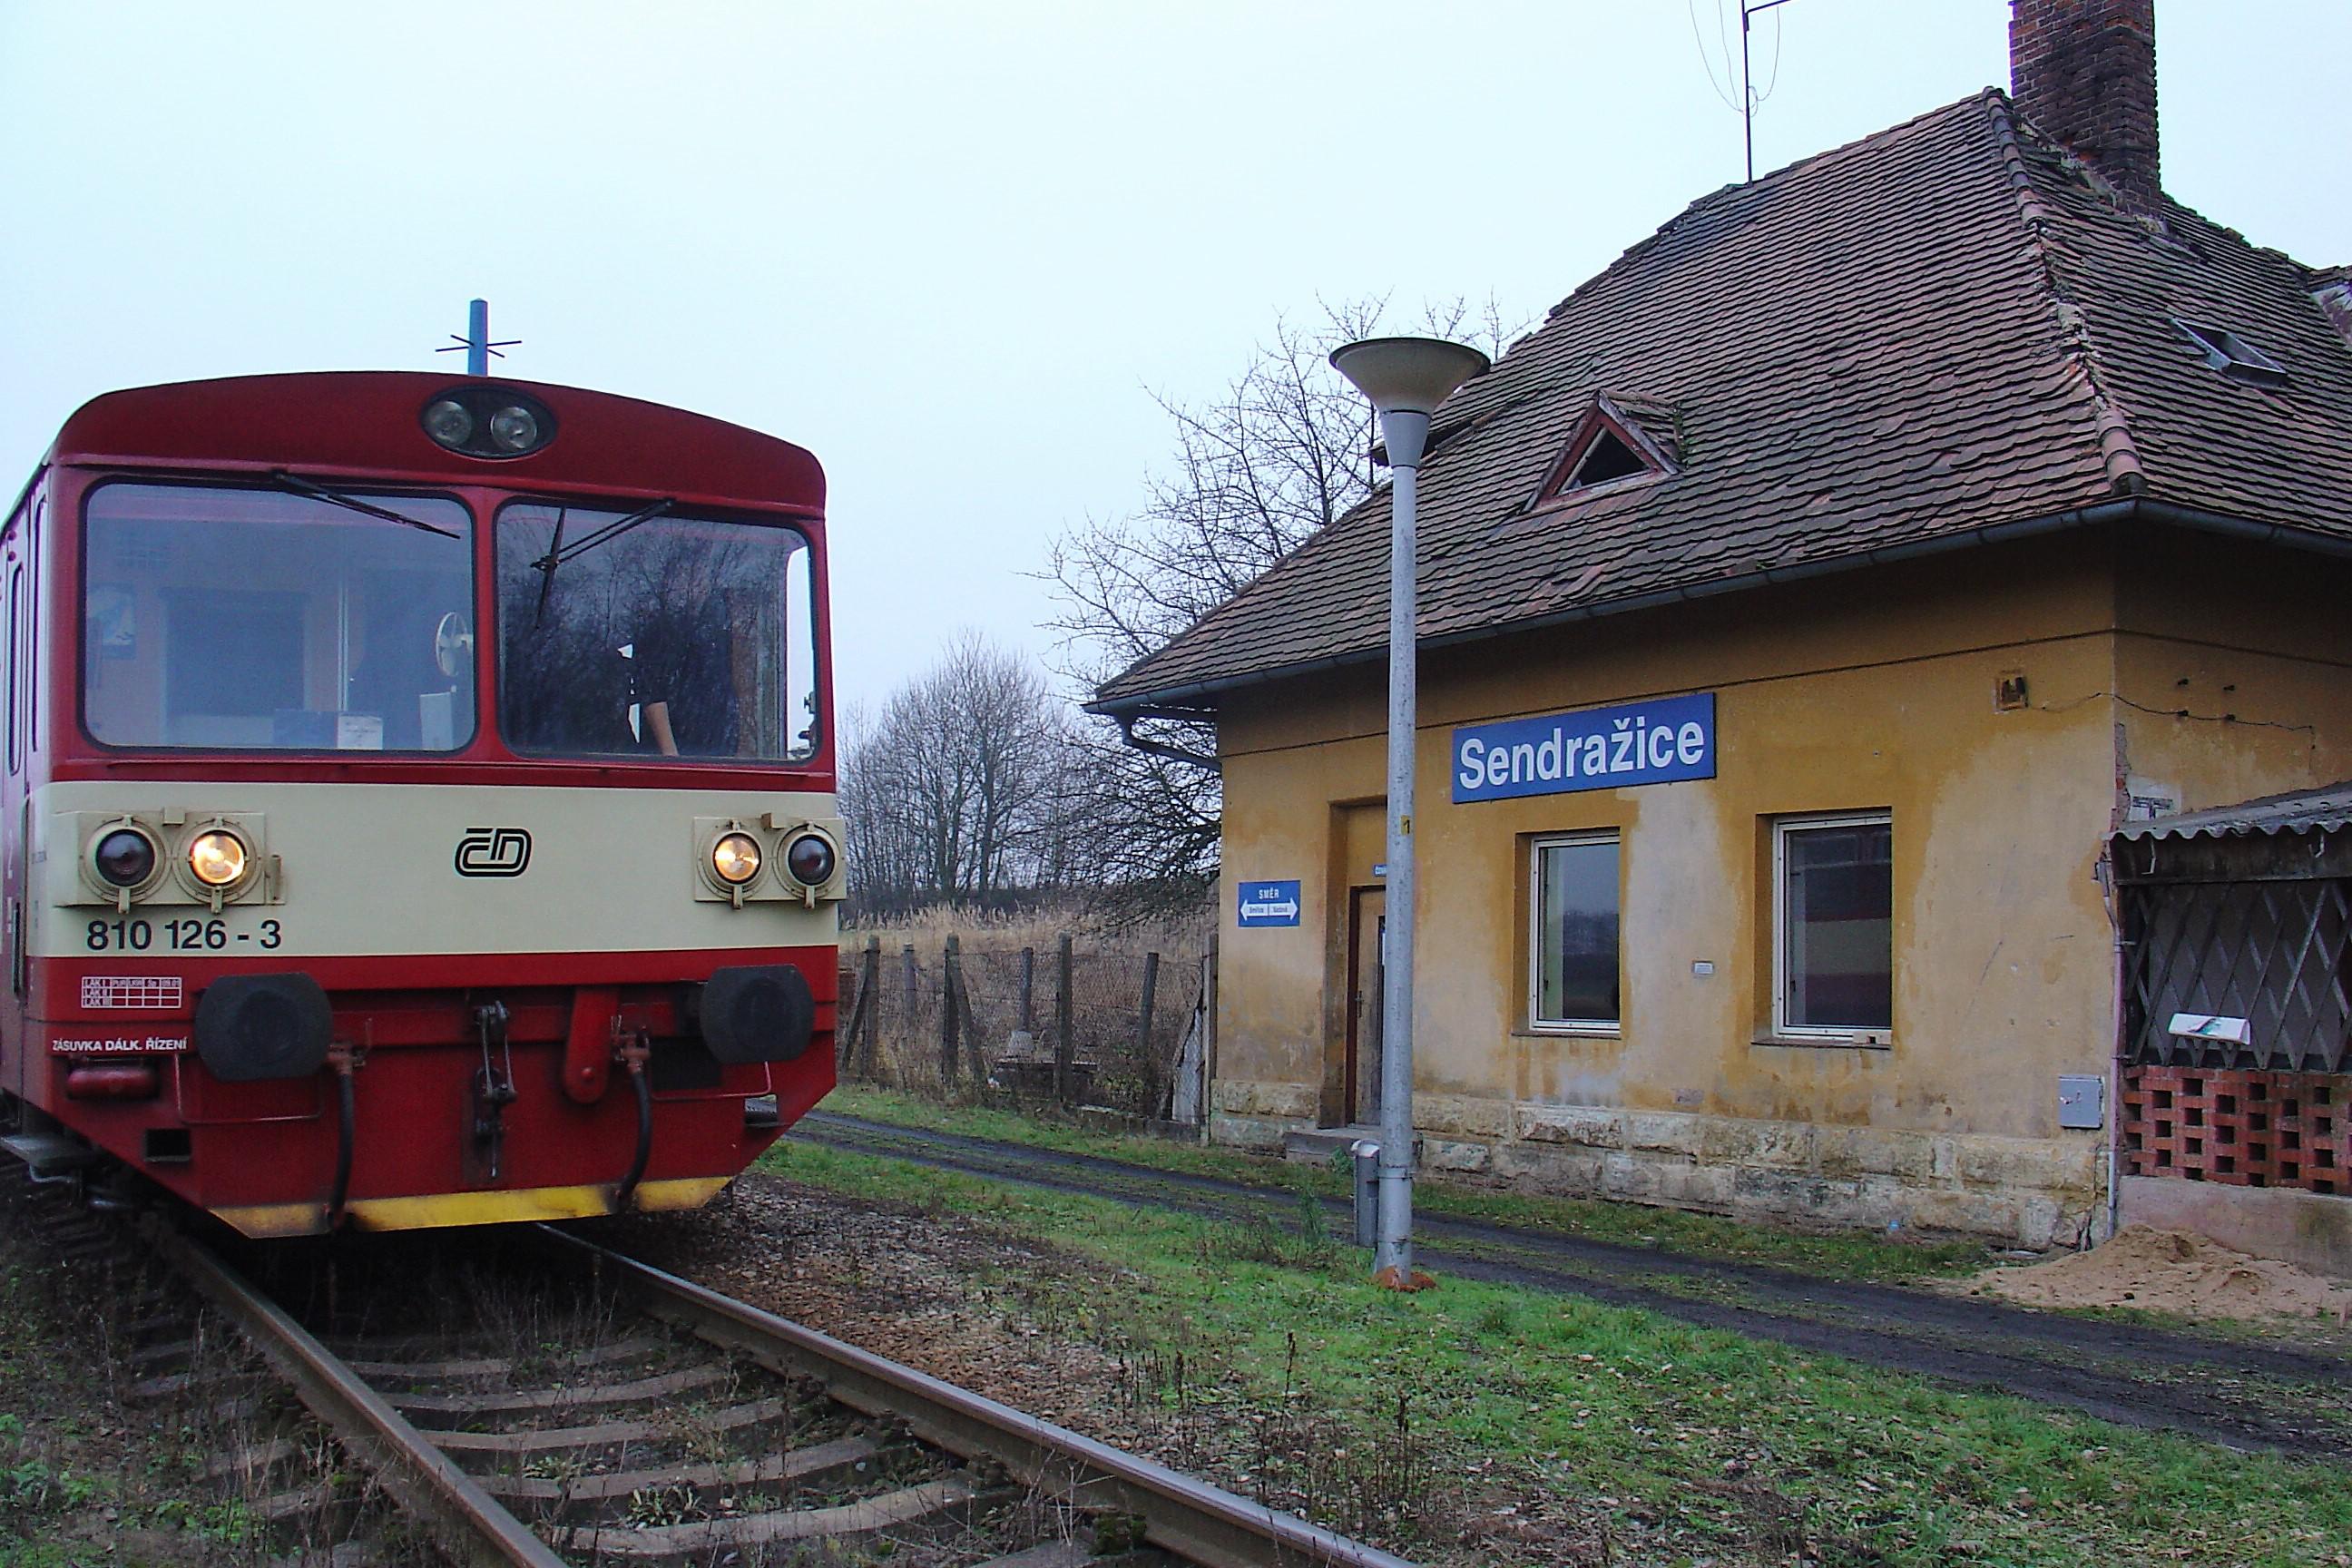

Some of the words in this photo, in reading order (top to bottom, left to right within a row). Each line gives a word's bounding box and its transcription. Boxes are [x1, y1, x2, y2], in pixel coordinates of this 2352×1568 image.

[1459, 716, 1704, 789] Sendražice
[1404, 819, 1410, 834] 1
[1259, 887, 1279, 899] SMĚR
[87, 920, 152, 950] 810
[164, 920, 226, 949] 126
[260, 920, 281, 949] 3
[84, 979, 101, 987] LAK
[84, 998, 101, 1006] LAK
[53, 1038, 103, 1051] ZÁSUVKA
[105, 1038, 142, 1051] DÁLK.
[146, 1036, 187, 1050] ŘÍZENÍ
